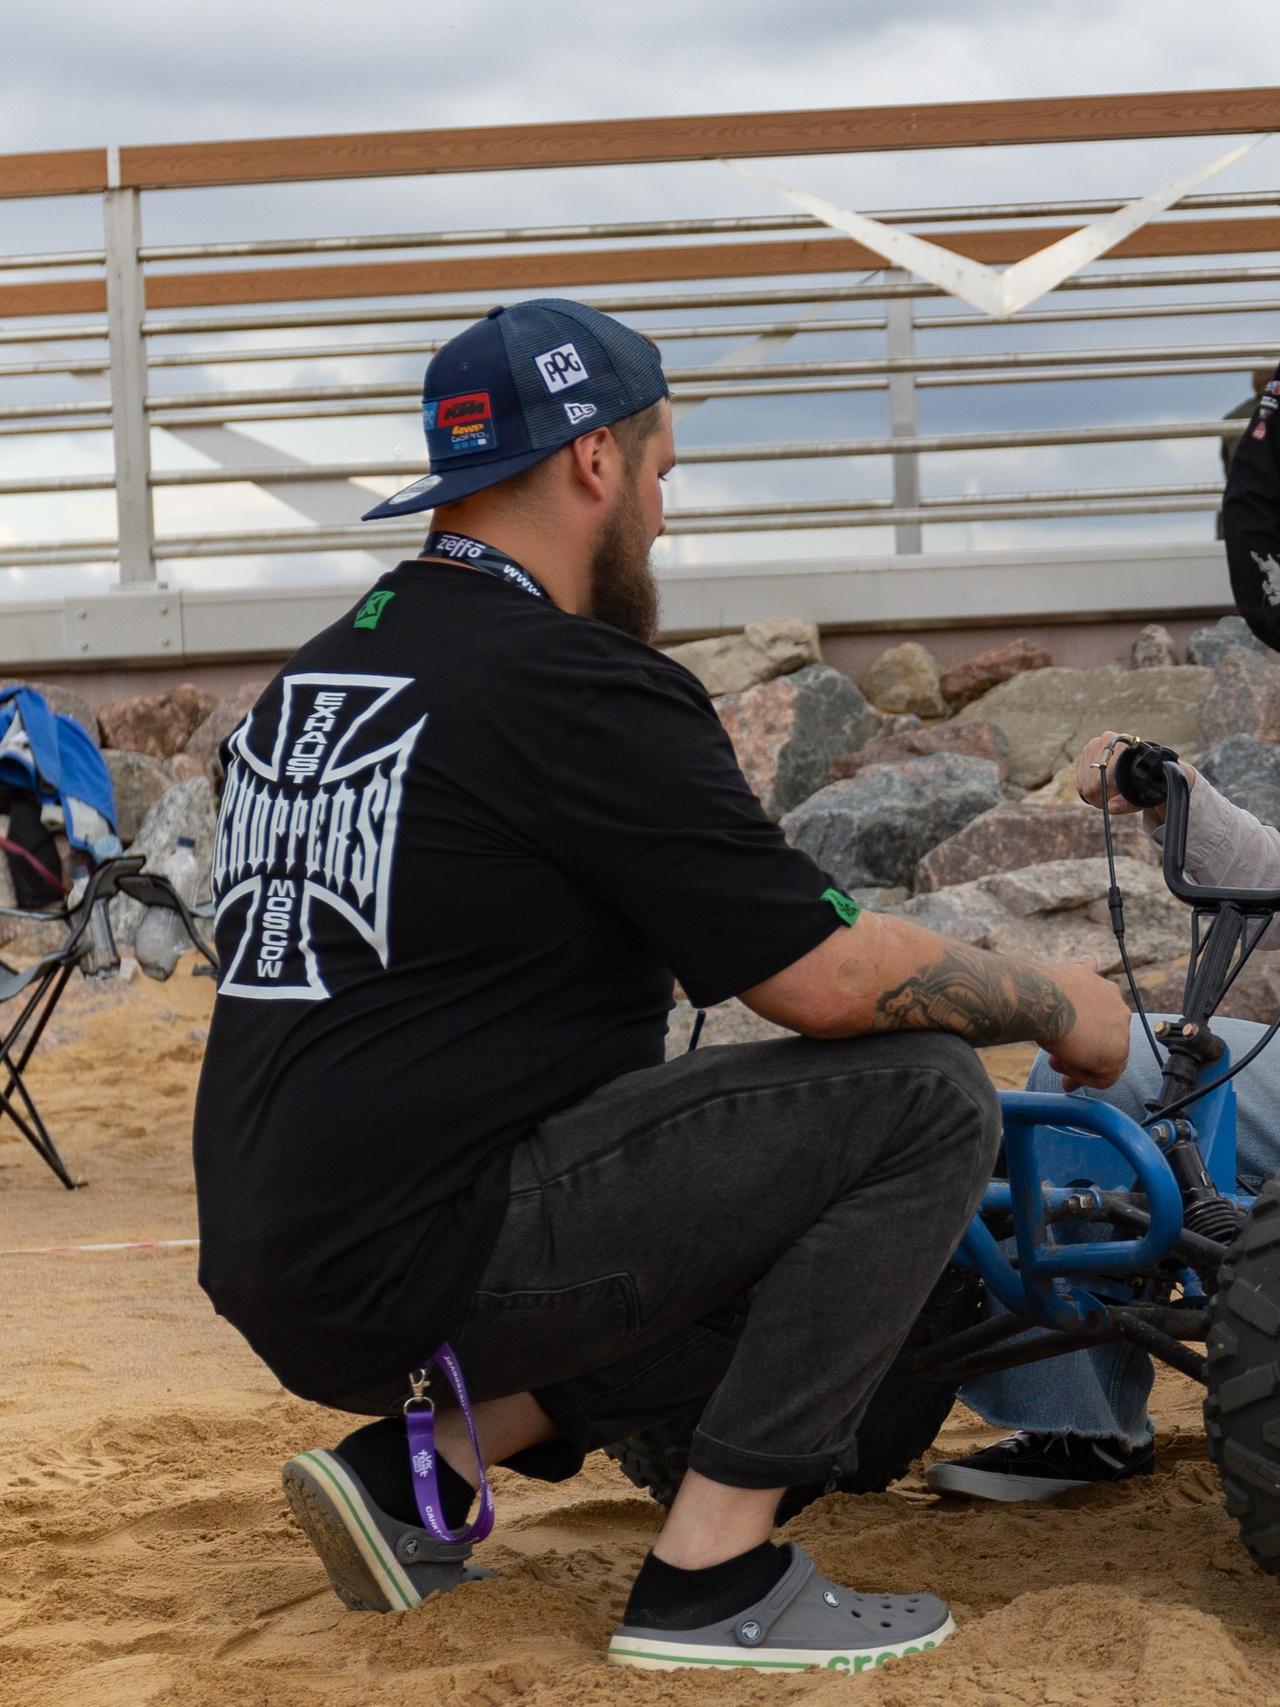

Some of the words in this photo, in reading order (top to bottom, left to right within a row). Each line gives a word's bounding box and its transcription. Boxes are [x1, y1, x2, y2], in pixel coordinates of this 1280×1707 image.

[544, 351, 582, 385] PPG
[285, 691, 347, 784] EXHAUST
[213, 755, 391, 910] CHOPPERS
[258, 879, 297, 978] MOSCOW
